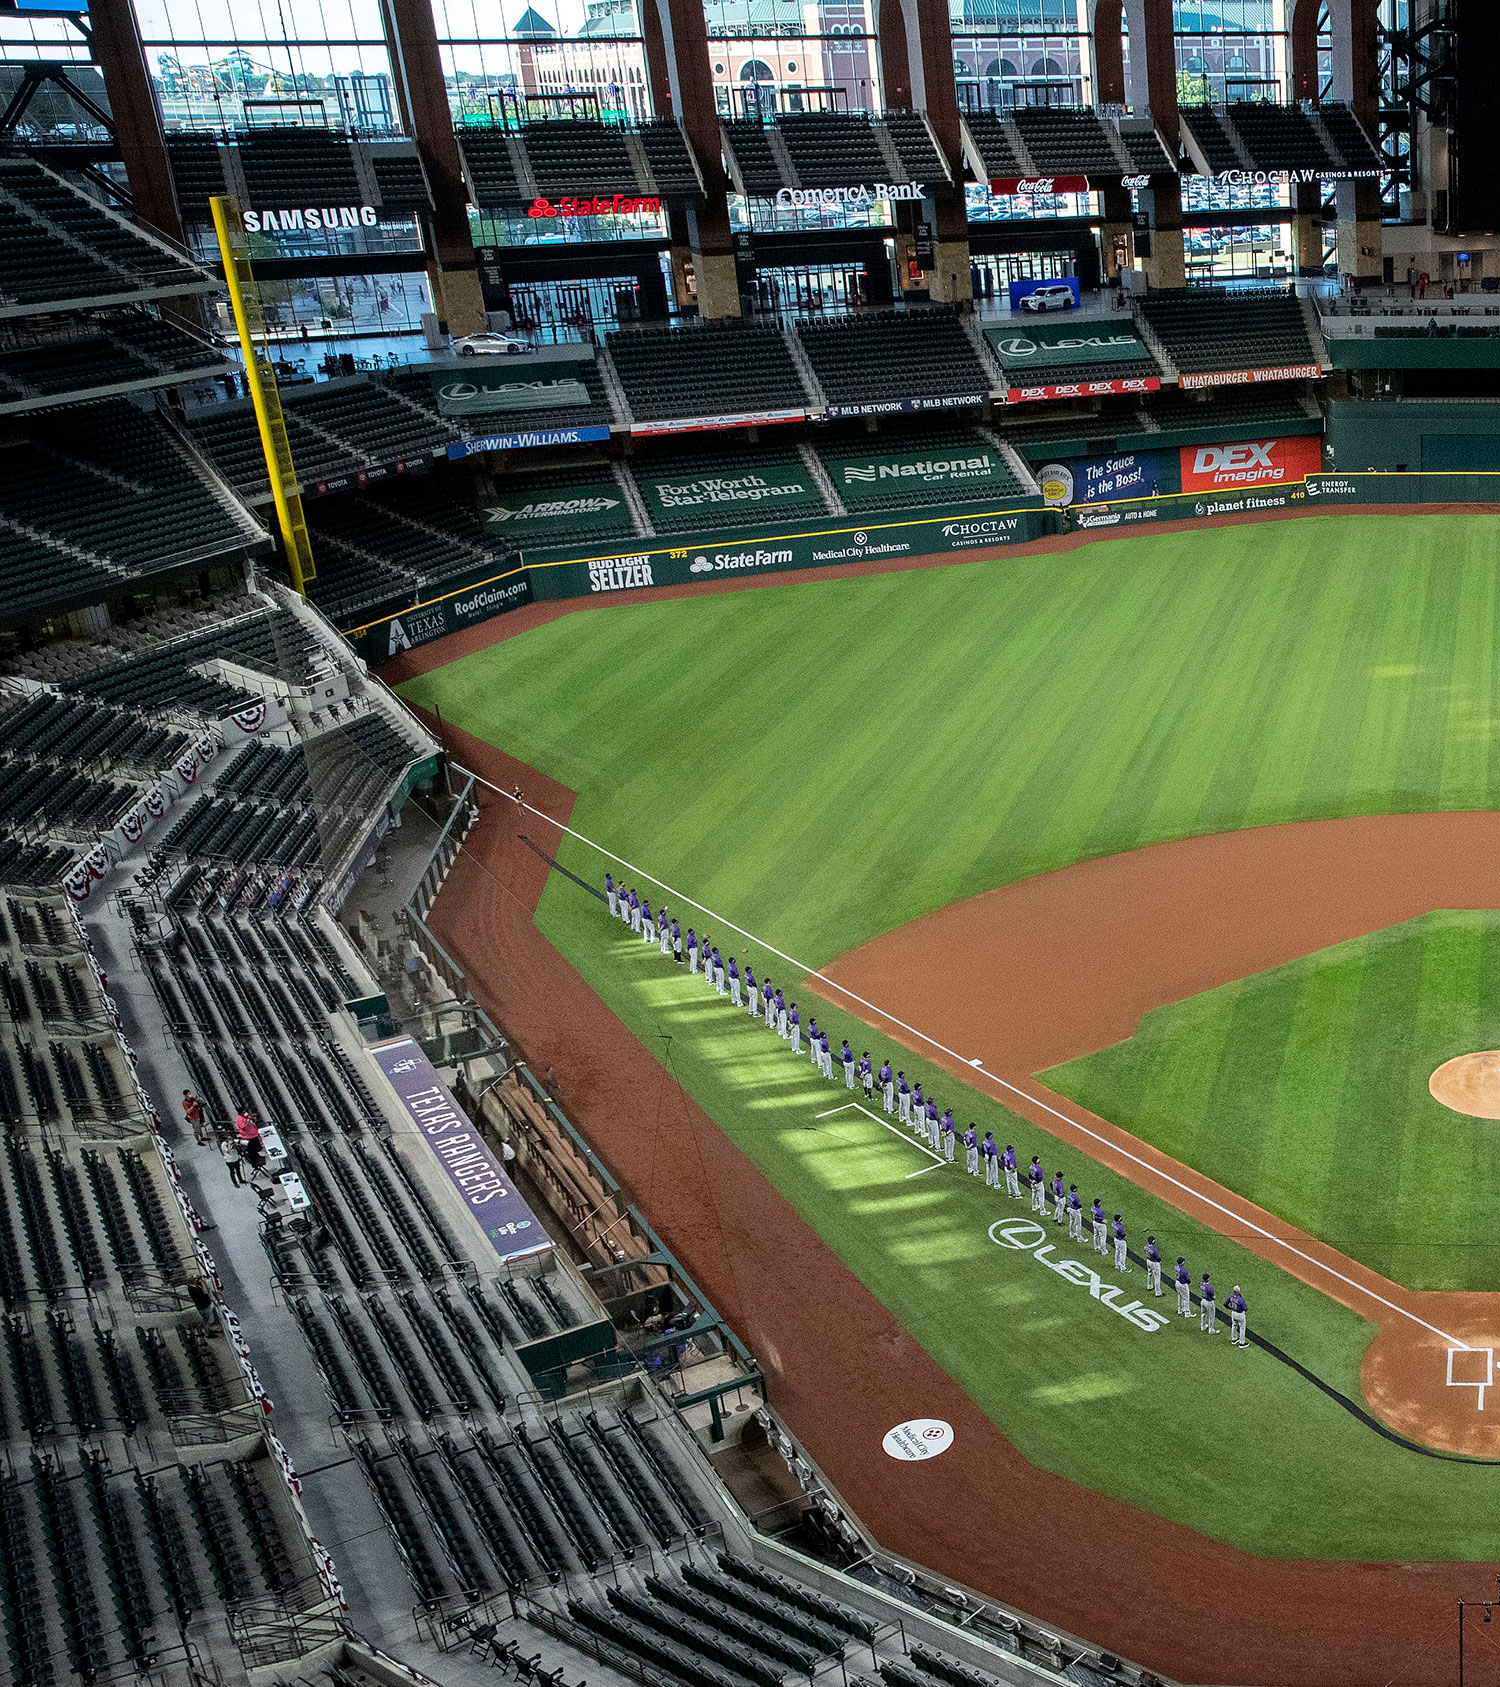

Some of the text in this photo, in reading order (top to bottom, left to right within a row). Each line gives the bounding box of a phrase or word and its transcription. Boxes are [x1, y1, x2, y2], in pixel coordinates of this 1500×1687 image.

[1121, 175, 1151, 187] Coca-Cola
[1228, 170, 1315, 185] CHOCTAW
[874, 181, 926, 200] Bank
[1017, 178, 1055, 193] Coca-Cola
[243, 206, 377, 232] SAMSUNG
[1040, 335, 1137, 350] LEXUS
[1122, 379, 1145, 388] DEX
[1182, 366, 1317, 387] WHATABURGER WHATABURGER
[482, 378, 579, 394] LEXUS
[1021, 388, 1045, 397] DEX
[1055, 385, 1080, 394] DEX
[1089, 382, 1113, 391] DEX
[841, 402, 903, 416] MLB NETWORK
[923, 395, 983, 409] MLB NETWORK
[406, 459, 424, 468] TOYOTA
[1192, 441, 1277, 474] DEX
[367, 468, 387, 478] TOYOTA
[924, 468, 992, 482] Car Rental
[1086, 465, 1104, 480] The
[1105, 456, 1135, 474] Sauce
[328, 479, 348, 490] TOYOTA
[655, 475, 767, 497] Fort Worth
[1087, 466, 1142, 498] is the Boss!
[1214, 467, 1285, 493] imaging
[660, 483, 805, 507] Star-Telegram
[1291, 491, 1305, 499] 410
[1321, 486, 1356, 494] TRANSFER
[514, 506, 601, 520] EXTERMINATORS
[520, 497, 601, 514] ARROW
[1207, 496, 1286, 516] planet fitness
[1089, 513, 1121, 523] Germania
[1124, 512, 1138, 520] AUTO
[1143, 509, 1157, 517] HOME
[949, 518, 1018, 536] CHOCTAW
[951, 539, 978, 547] CASINOS
[669, 550, 688, 559] 372
[812, 541, 910, 561] Medical City Healthcare
[588, 555, 650, 570] BUD LIGHT
[589, 565, 654, 592] SELTZER
[454, 581, 528, 616] RoofClaim.com
[406, 608, 435, 622] UNIVERSITY
[408, 612, 445, 636] TEXAS
[411, 624, 447, 645] ARLINGTON
[406, 1086, 507, 1205] TEXAS RANGERS
[1034, 1244, 1170, 1333] LEXUS
[900, 1425, 922, 1446] Medical
[890, 1432, 917, 1459] Healthcare
